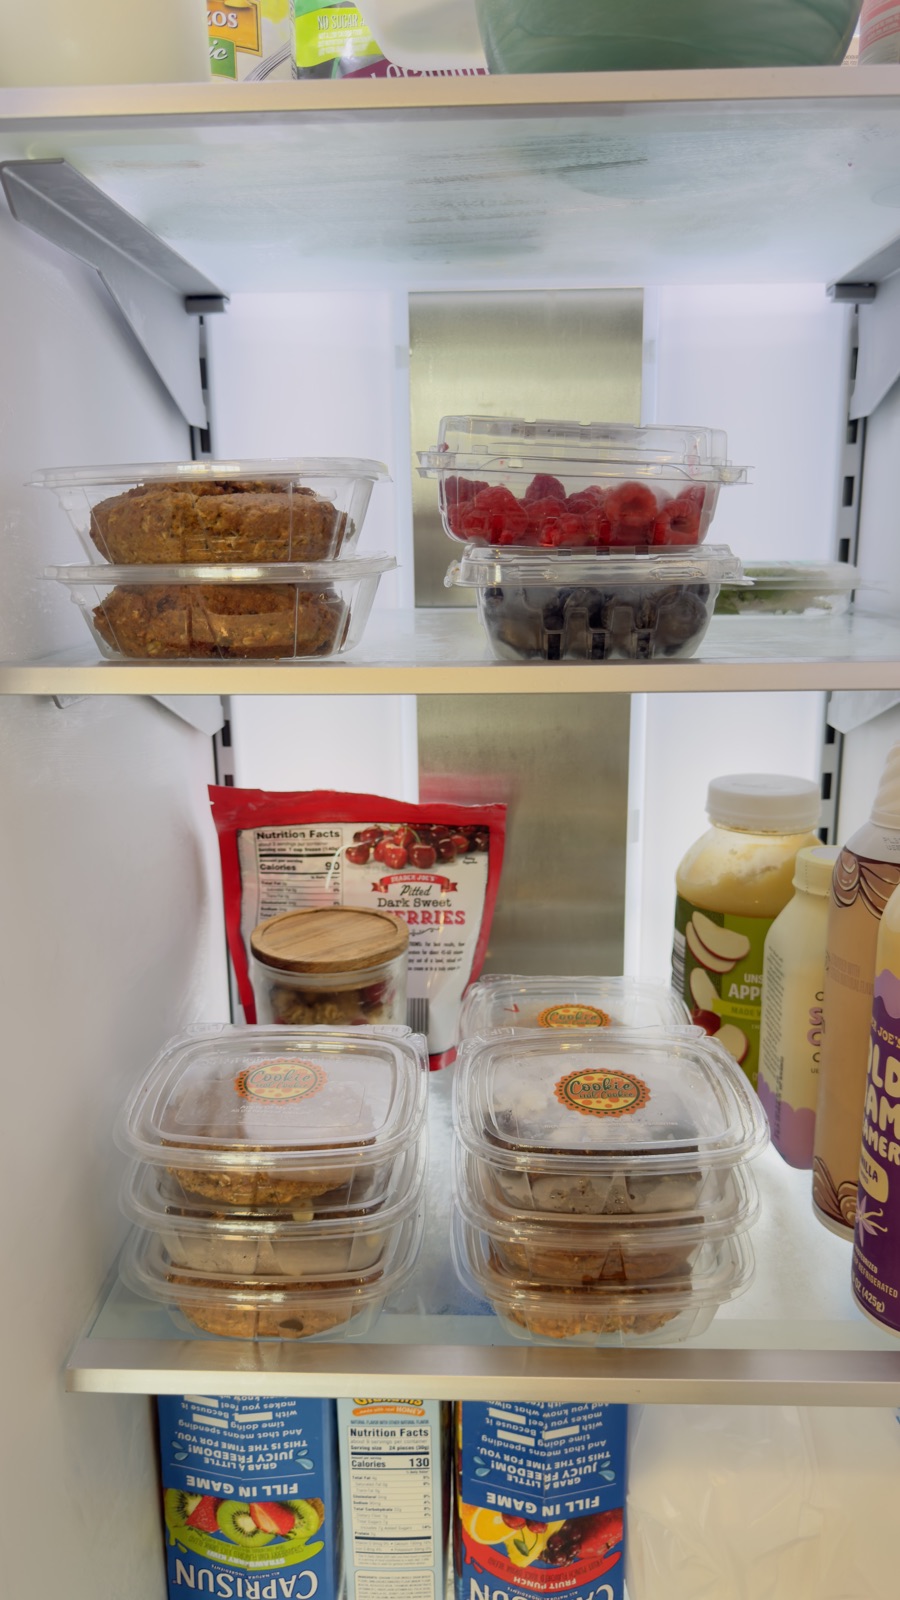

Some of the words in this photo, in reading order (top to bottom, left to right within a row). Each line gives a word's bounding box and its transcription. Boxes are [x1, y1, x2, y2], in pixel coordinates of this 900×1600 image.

[318, 15, 329, 30] NO
[331, 14, 359, 29] SUGAR
[256, 831, 305, 839] Nutrition
[309, 830, 340, 838] Facts
[325, 862, 340, 870] 90
[400, 884, 432, 896] Pitted
[378, 898, 410, 908] Dark
[413, 898, 452, 908] Sweet
[387, 910, 466, 925] ERRIES
[550, 1012, 598, 1021] Cookie
[250, 1070, 311, 1084] Cookie
[570, 1078, 631, 1095] Cookie
[600, 1091, 635, 1100] Cookie
[862, 1286, 885, 1313] (425g)
[181, 1402, 188, 1410] it
[221, 1402, 239, 1411] feel
[242, 1403, 260, 1411] you
[396, 1406, 422, 1415] HONEY
[514, 1405, 540, 1416] what
[571, 1403, 588, 1412] you
[190, 1405, 229, 1418] Because
[275, 1410, 297, 1418] with
[542, 1408, 568, 1418] know
[550, 1417, 568, 1427] you
[571, 1411, 602, 1423] makes
[178, 1419, 220, 1436] spending
[230, 1421, 258, 1431] doing
[262, 1421, 284, 1429] time
[495, 1421, 537, 1436] Because
[528, 1419, 548, 1429] feel
[582, 1421, 603, 1431] with
[175, 1431, 197, 1442] YOU.
[223, 1431, 254, 1440] means
[257, 1431, 279, 1439] that
[282, 1428, 302, 1436] And
[350, 1428, 396, 1437] Nutrition
[400, 1428, 428, 1436] Facts
[200, 1437, 219, 1447] FOR
[284, 1440, 307, 1448] THIS
[481, 1434, 526, 1452] spending
[537, 1438, 566, 1448] doing
[568, 1434, 590, 1444] time
[221, 1441, 246, 1452] TIME
[249, 1444, 269, 1452] THE
[564, 1445, 585, 1454] that
[588, 1439, 606, 1450] And
[188, 1444, 253, 1463] FREEDOM!
[256, 1449, 294, 1462] JUICY
[477, 1446, 500, 1460] YOU.
[529, 1448, 561, 1457] means
[588, 1451, 610, 1462] THIS
[204, 1457, 236, 1469] LITTLE
[409, 1458, 429, 1467] 130
[503, 1454, 523, 1465] FOR
[554, 1459, 574, 1469] THE
[576, 1456, 586, 1464] IS
[239, 1463, 245, 1471] A
[249, 1462, 277, 1471] GRAB
[526, 1460, 551, 1470] TIME
[562, 1462, 597, 1478] JUICY
[491, 1460, 558, 1482] FREEDOM!
[186, 1474, 234, 1494] GAME
[507, 1474, 540, 1488] LITTLE
[544, 1482, 550, 1490] A
[553, 1477, 581, 1489] GRAB
[238, 1486, 257, 1497] IN
[262, 1483, 298, 1495] FILL
[486, 1492, 537, 1514] GAME
[565, 1496, 600, 1512] FILL
[542, 1504, 560, 1516] IN
[206, 1550, 227, 1560] KIWI
[211, 1564, 245, 1577] INGREDIENTS
[175, 1558, 318, 1599] CAPRISUN
[513, 1576, 547, 1590] PUNCH
[549, 1577, 576, 1589] FRUIT
[507, 1586, 542, 1600] INGREDIENTS
